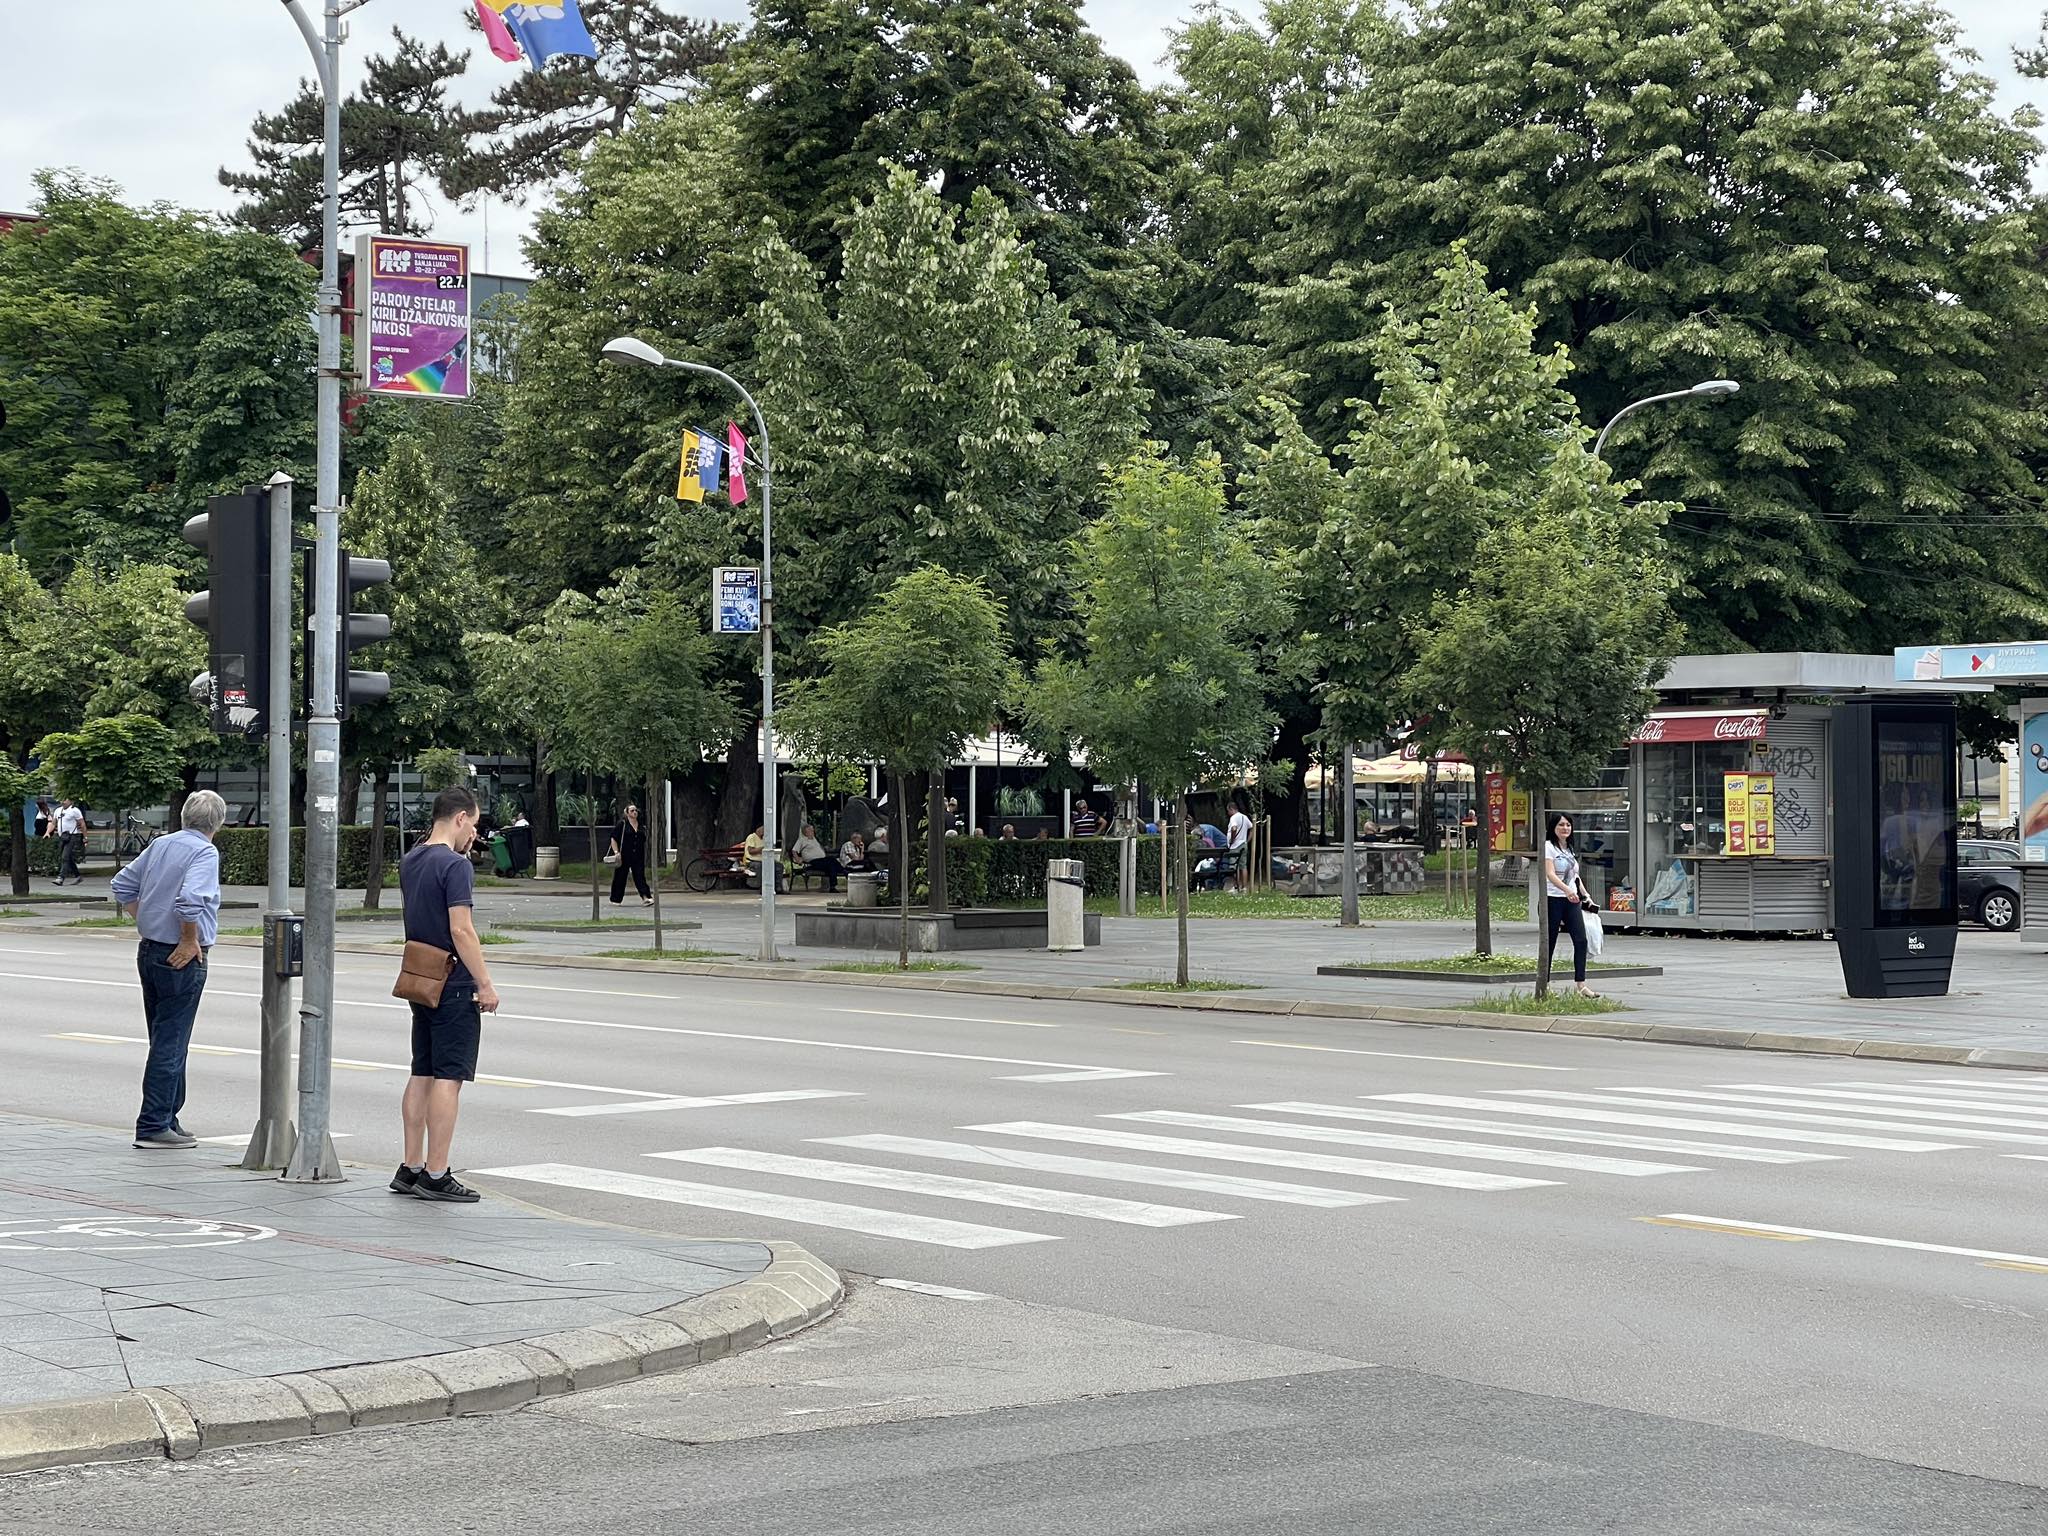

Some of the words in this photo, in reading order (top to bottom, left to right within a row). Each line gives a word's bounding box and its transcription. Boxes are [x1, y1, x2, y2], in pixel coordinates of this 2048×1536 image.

[414, 260, 432, 268] BANJA
[438, 254, 458, 262] KASTEL
[440, 276, 464, 288] 22.7.
[372, 291, 410, 308] PAROV
[414, 296, 456, 313] STELAR
[372, 306, 398, 322] KIRIL
[400, 307, 467, 328] DŽAJKOVSKI
[372, 320, 412, 338] MKDSL
[1998, 647, 2036, 656] ЛУТРИЈА
[1714, 716, 1766, 738] Coca-Cola
[1489, 795, 1503, 804] 20
